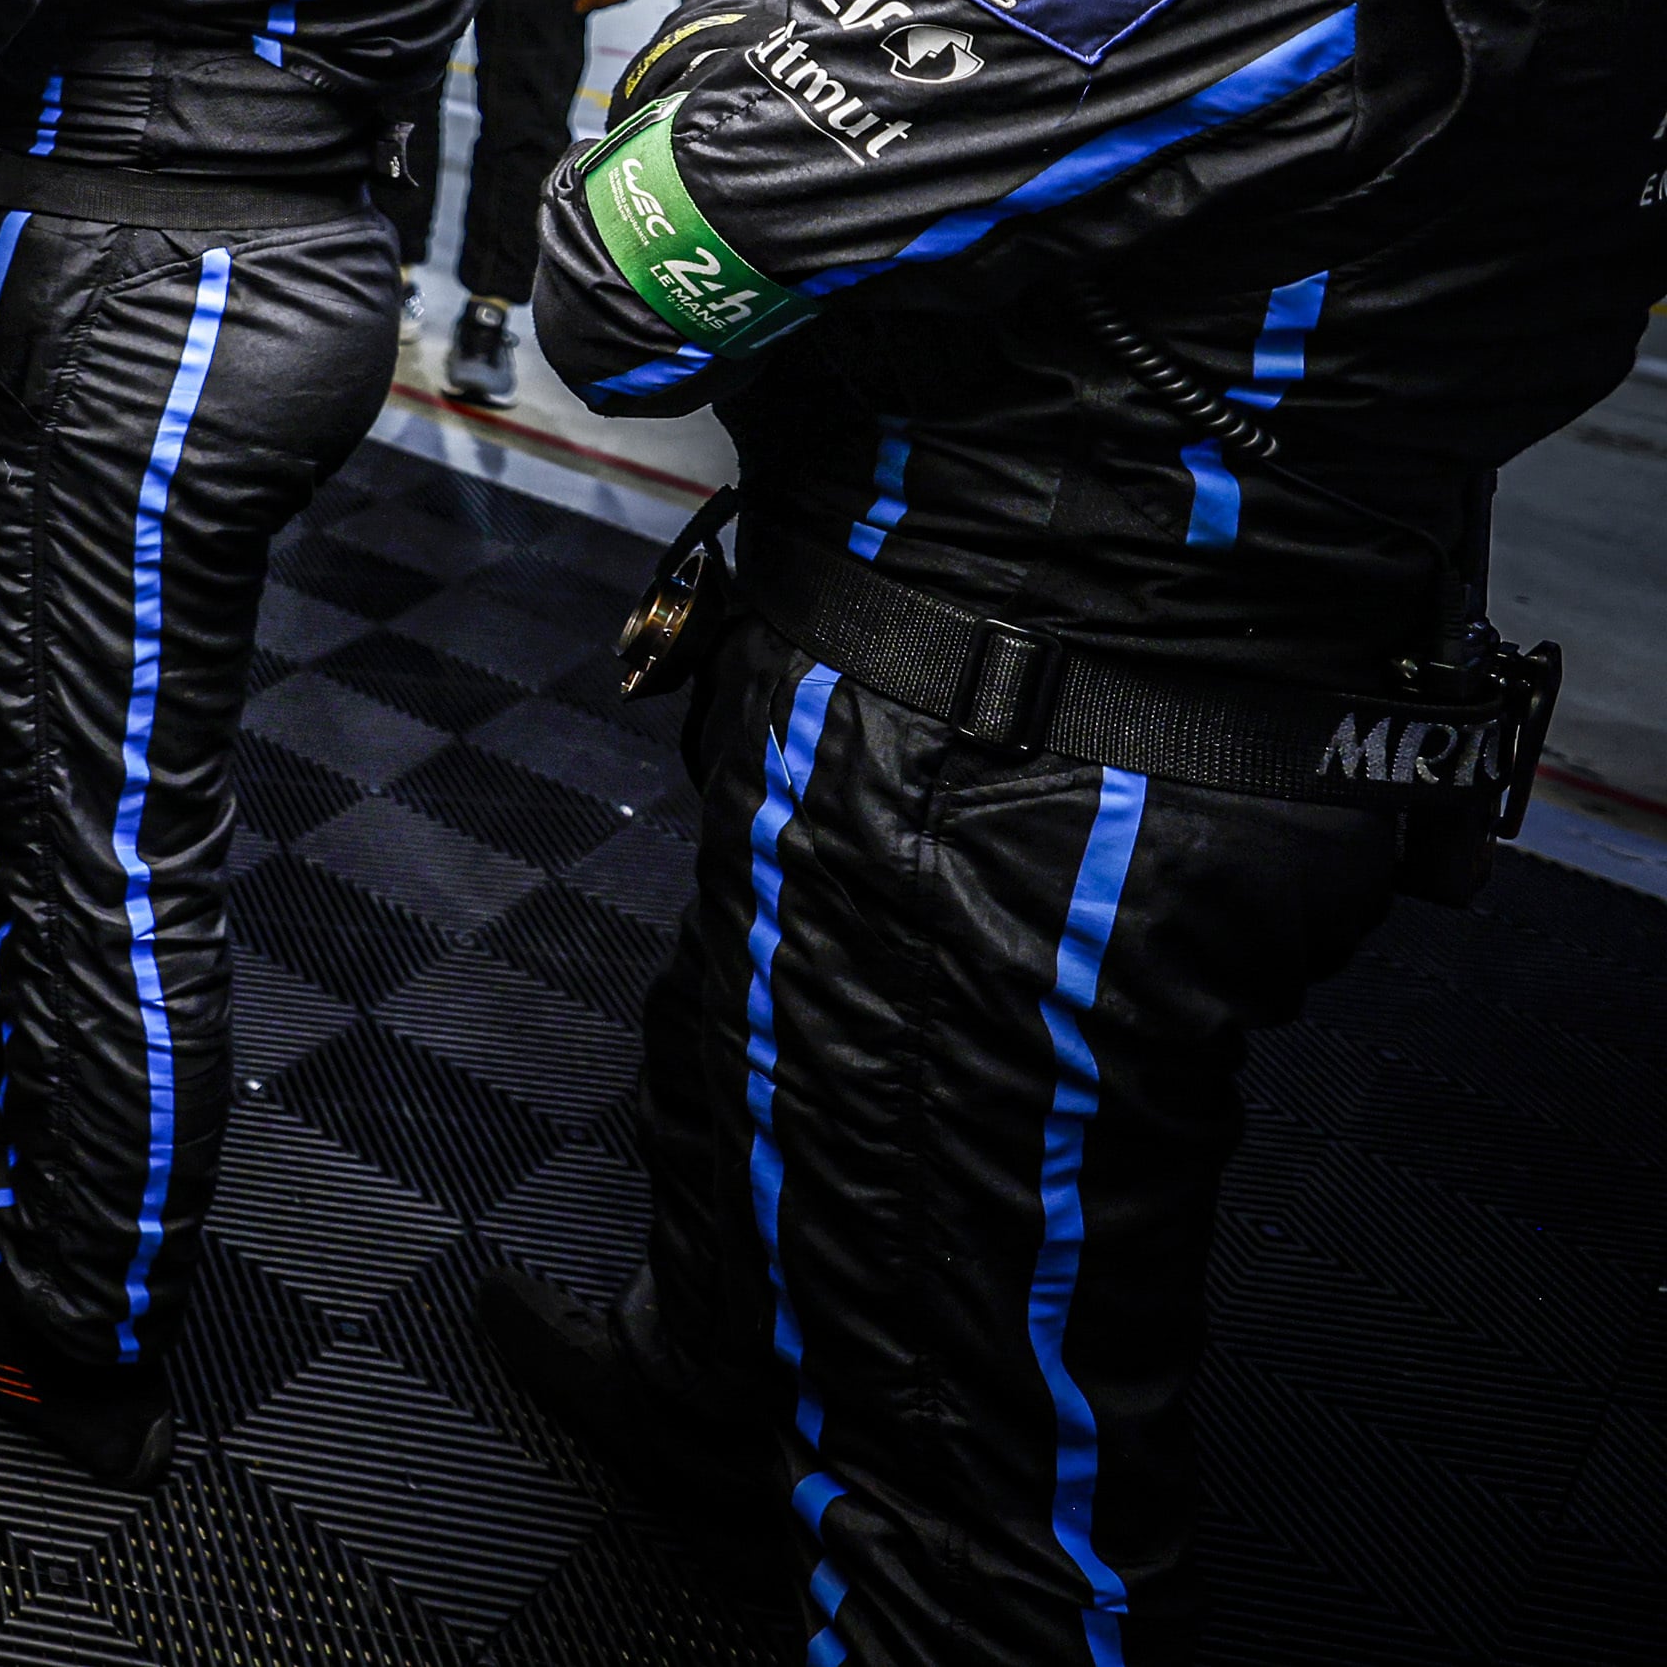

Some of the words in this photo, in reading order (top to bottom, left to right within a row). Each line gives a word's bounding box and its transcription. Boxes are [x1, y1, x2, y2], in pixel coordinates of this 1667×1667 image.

[621, 157, 676, 238] WEC
[650, 263, 673, 287] LE
[671, 287, 727, 332] MANS
